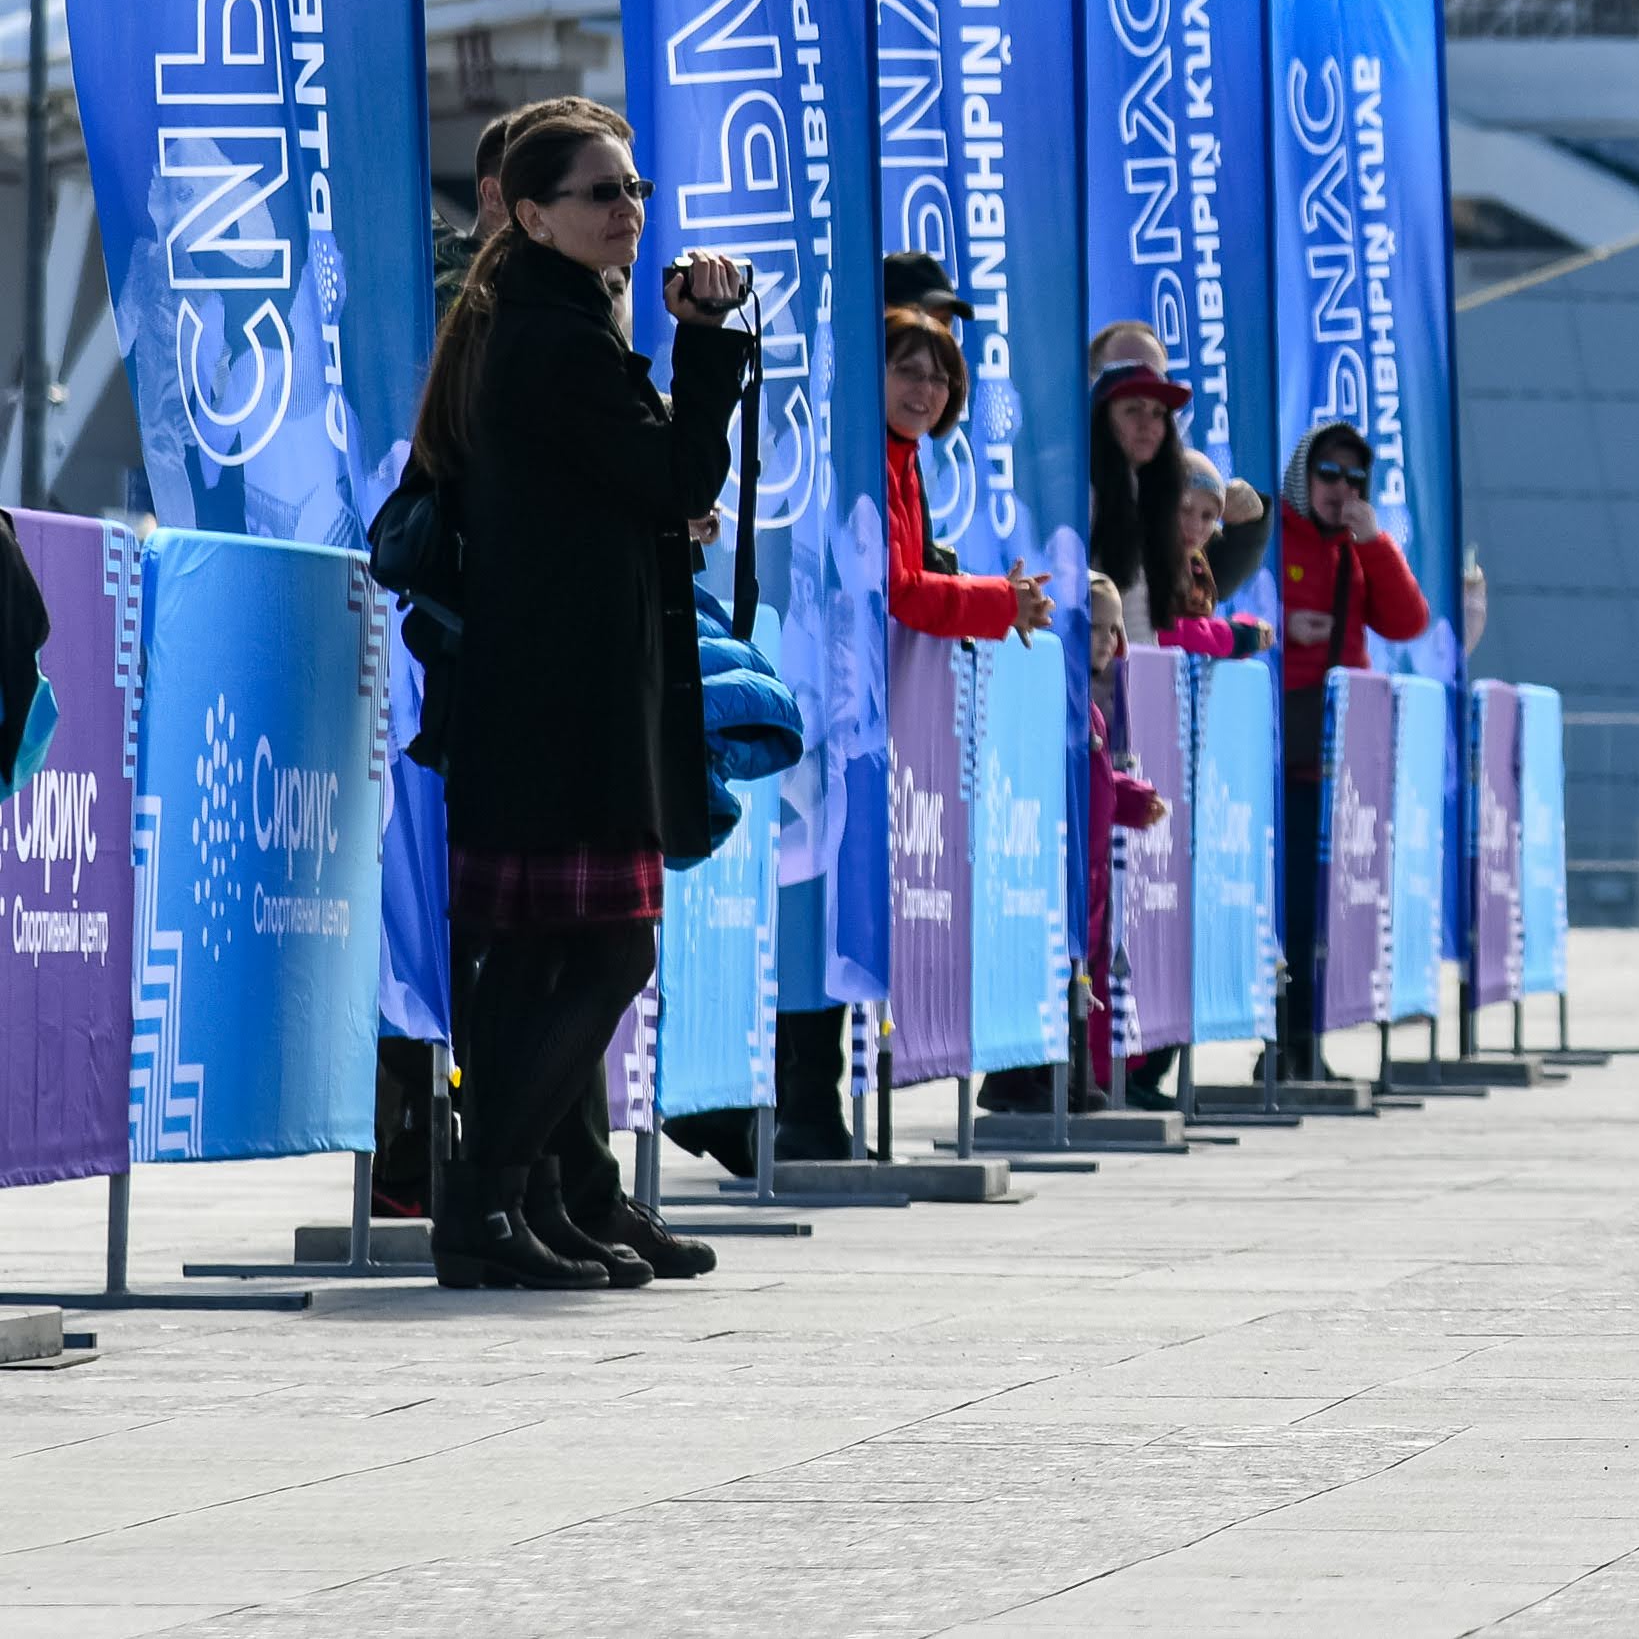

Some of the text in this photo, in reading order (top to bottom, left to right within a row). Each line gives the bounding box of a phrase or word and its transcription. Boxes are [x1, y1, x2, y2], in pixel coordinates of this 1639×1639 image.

[14, 769, 97, 894] Сириус
[253, 734, 339, 881] Сириус
[903, 766, 944, 879] Сириус
[13, 893, 109, 968] Спортивный центр
[253, 881, 350, 951] Спортивный центр
